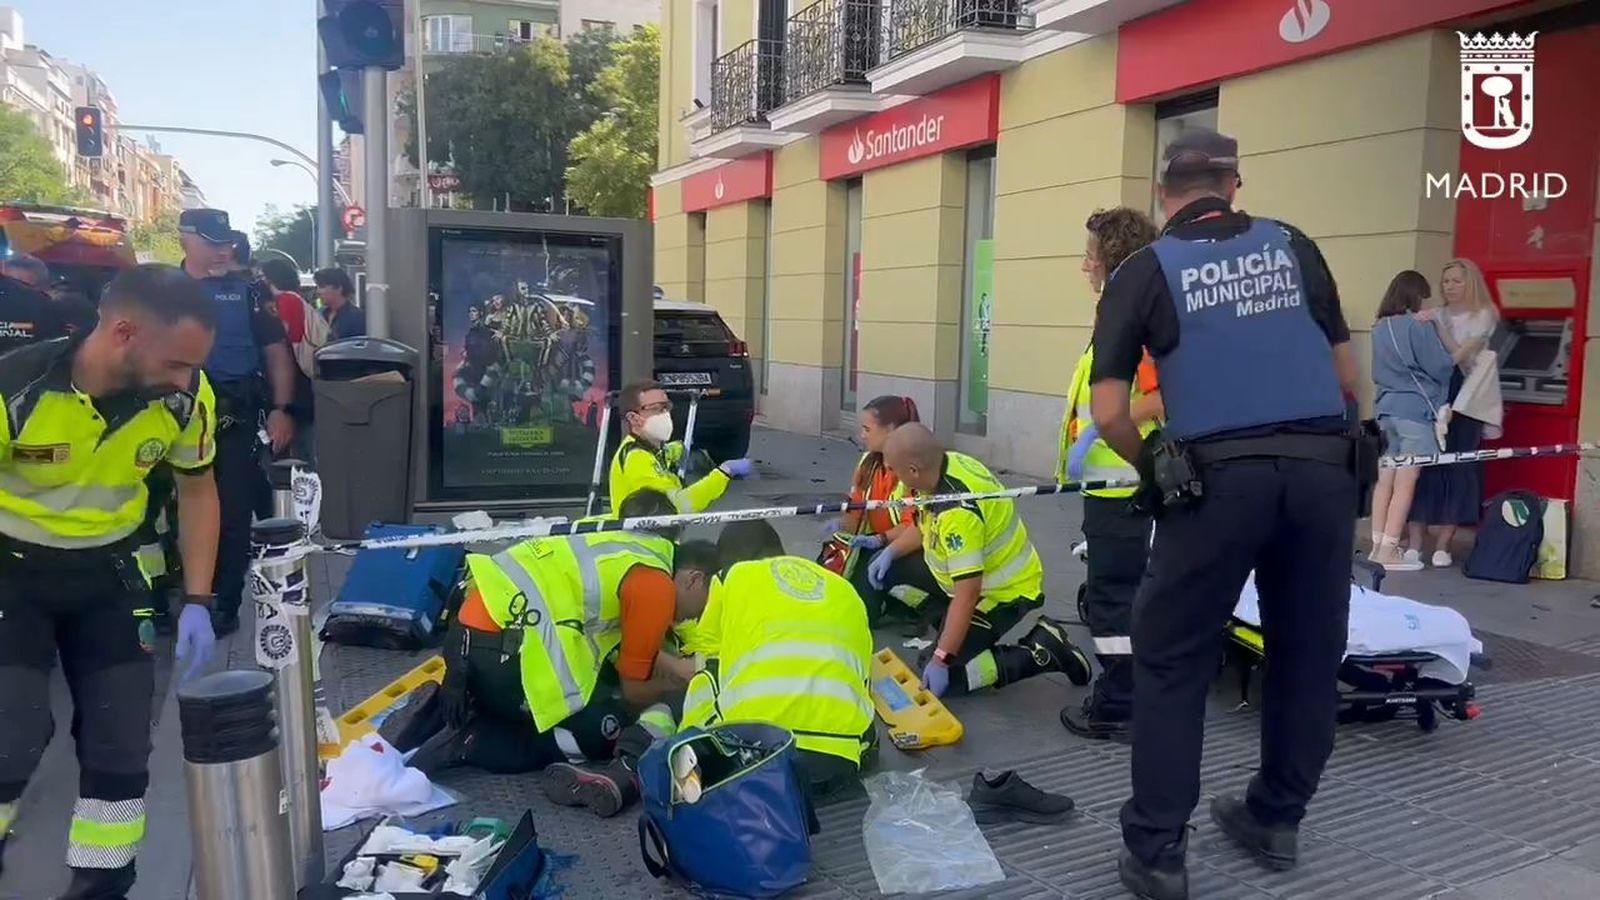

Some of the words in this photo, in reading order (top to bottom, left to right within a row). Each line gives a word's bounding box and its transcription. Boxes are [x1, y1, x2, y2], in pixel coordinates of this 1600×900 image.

[866, 113, 944, 161] Santander
[1180, 242, 1293, 291] POLICÍA
[1185, 270, 1299, 313] MUNICIPAL
[1236, 290, 1301, 318] Madrid
